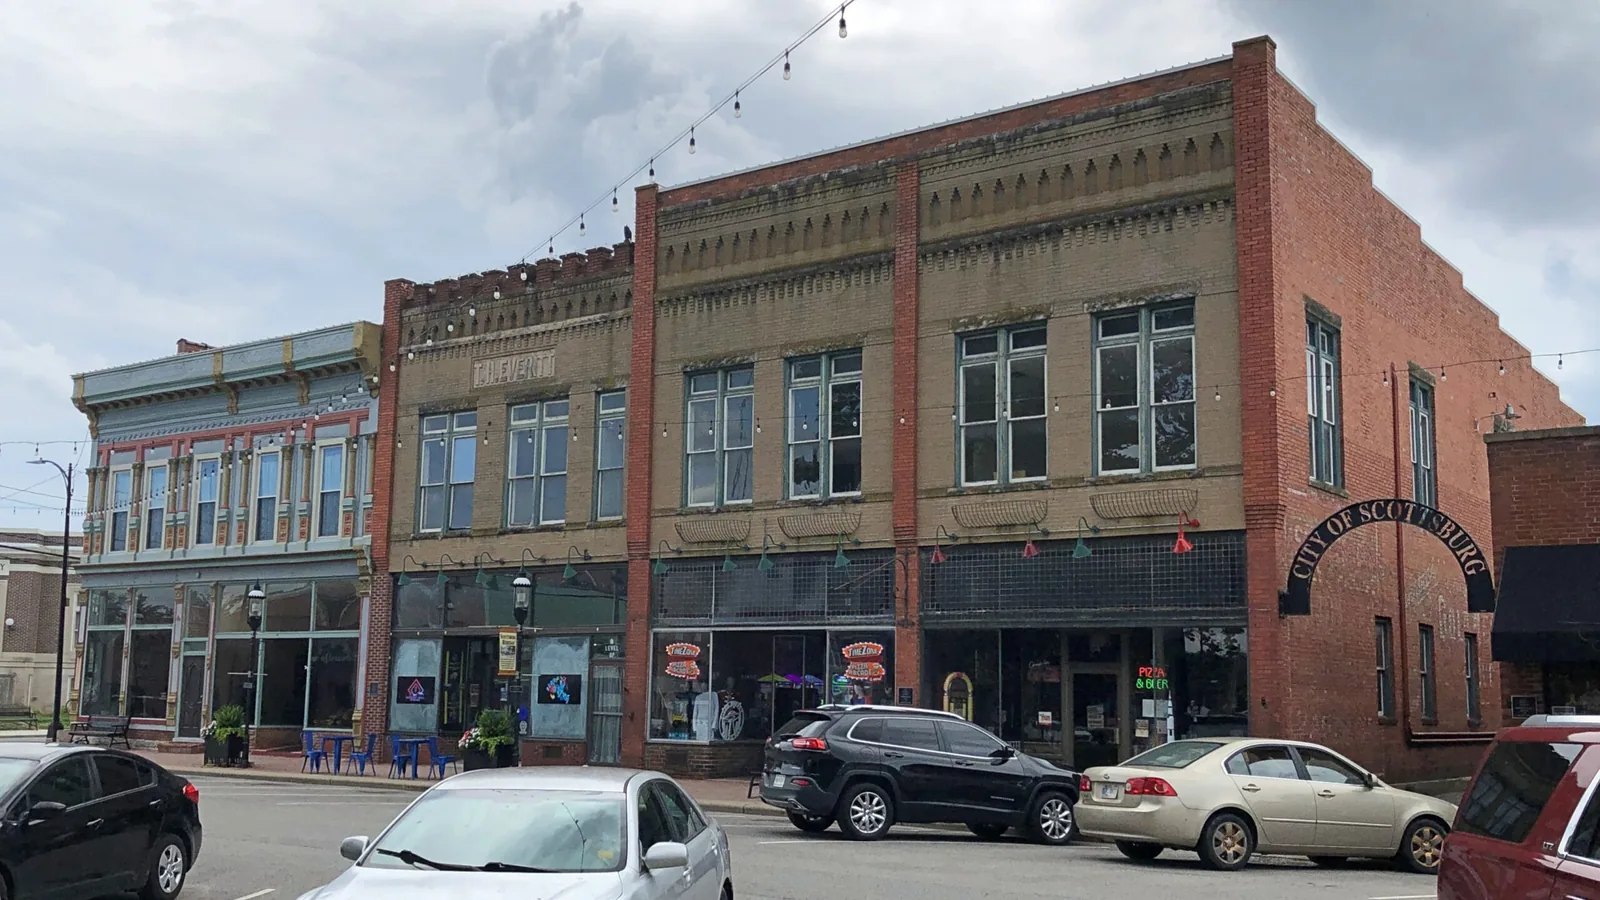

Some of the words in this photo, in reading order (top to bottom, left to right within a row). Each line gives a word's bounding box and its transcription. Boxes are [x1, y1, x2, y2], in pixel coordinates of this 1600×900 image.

[1293, 532, 1328, 579] CITY
[1327, 509, 1353, 535] OF
[1359, 501, 1486, 576] SCOTTSBURG
[1139, 667, 1165, 677] PIZZA
[1135, 678, 1144, 689] &
